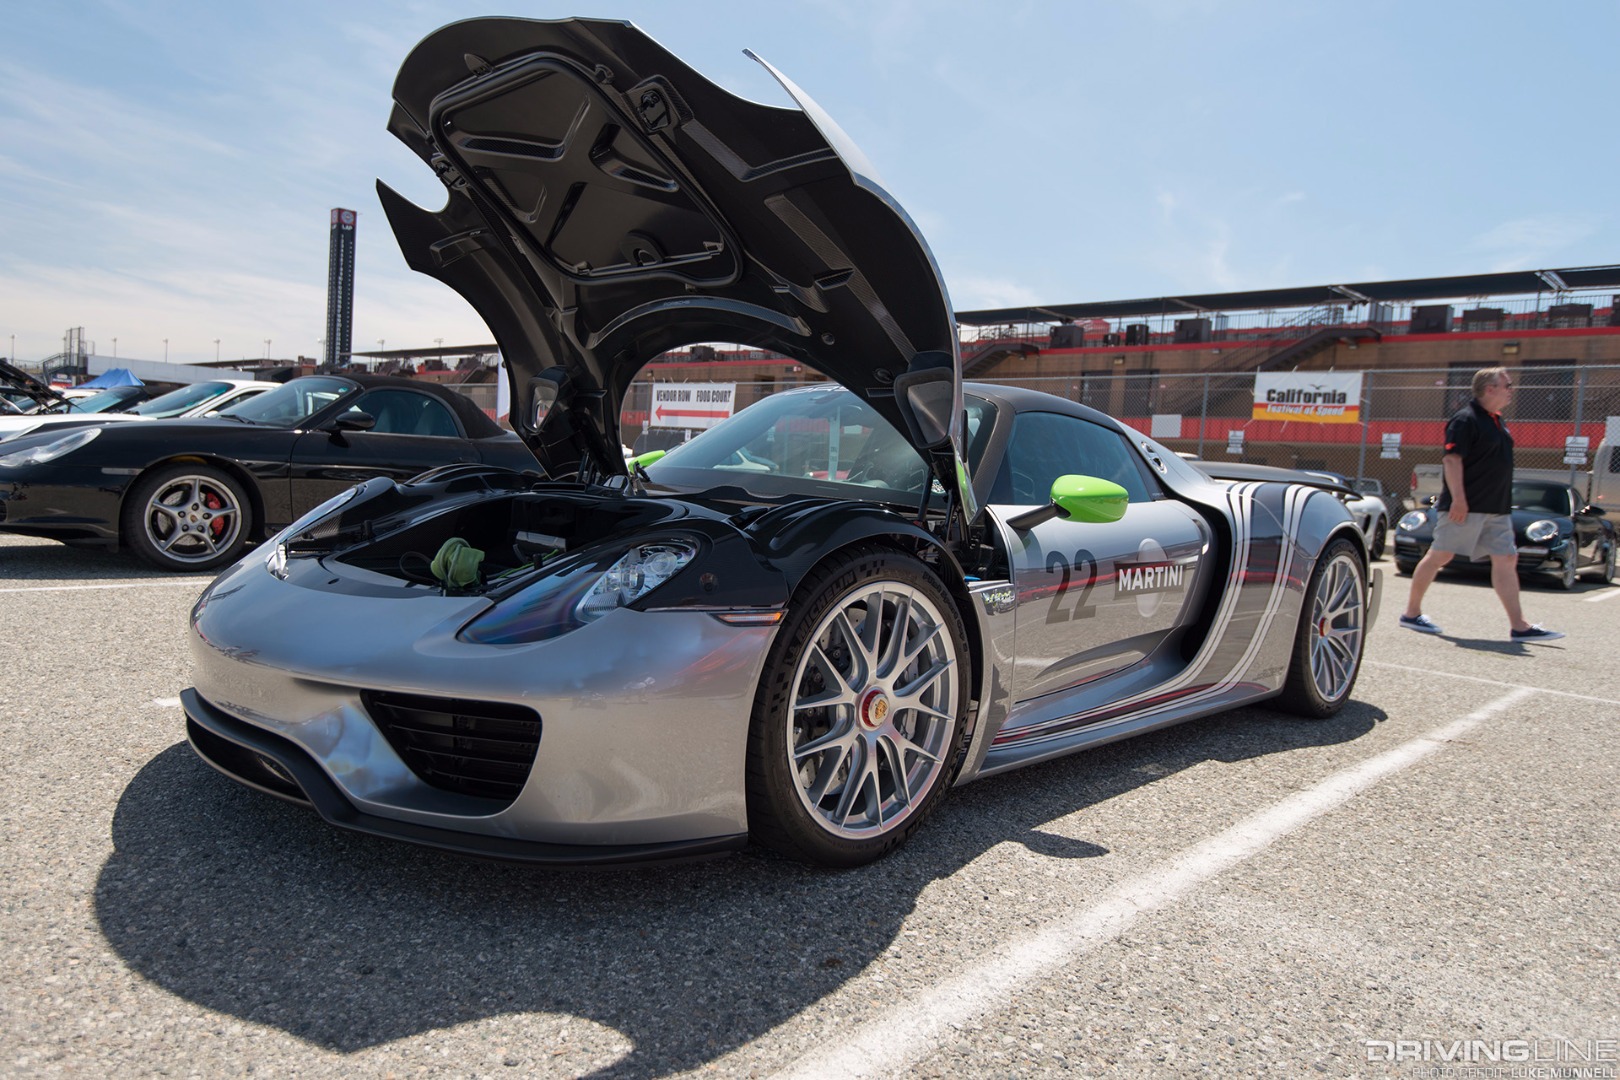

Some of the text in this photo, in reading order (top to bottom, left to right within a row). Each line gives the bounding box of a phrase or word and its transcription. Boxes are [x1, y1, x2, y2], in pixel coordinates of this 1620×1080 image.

[656, 390, 732, 402] VENDOR ROW FOOD COURT
[1266, 389, 1347, 404] California
[1266, 404, 1346, 416] Festival of Speed
[1045, 549, 1098, 625] 22
[1118, 565, 1184, 592] MARTINI
[796, 570, 855, 642] MICHELIN
